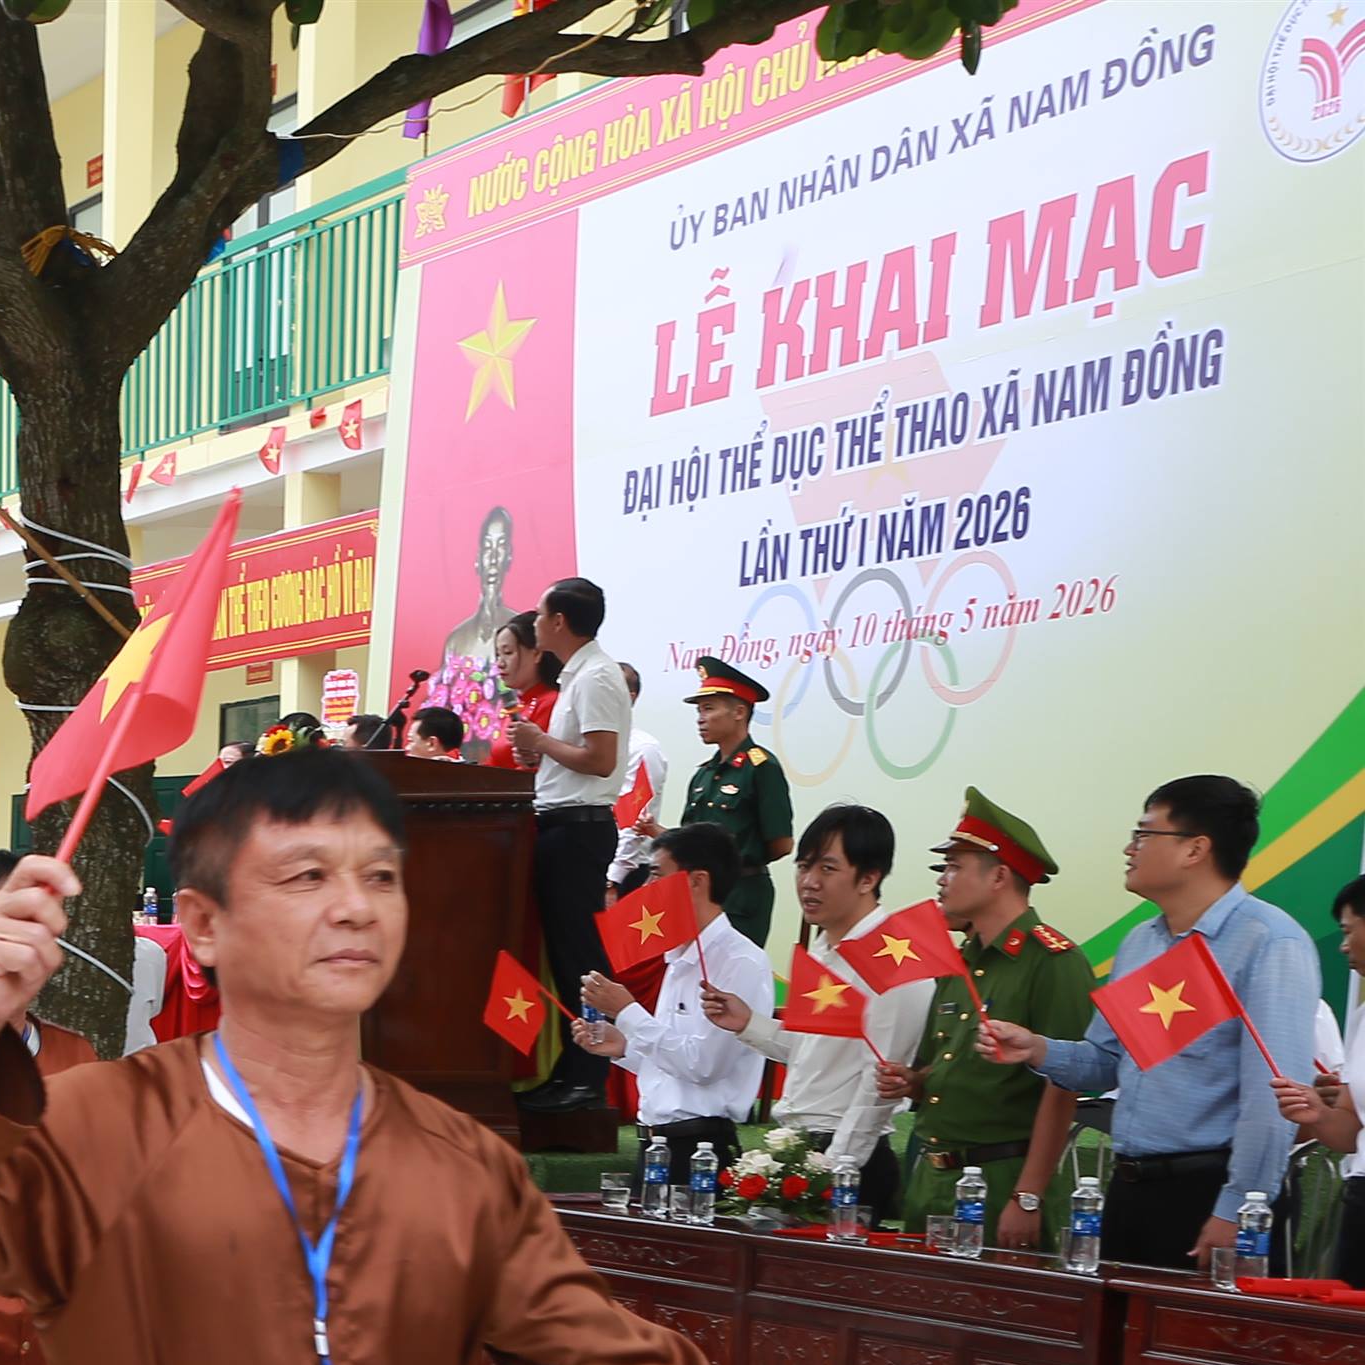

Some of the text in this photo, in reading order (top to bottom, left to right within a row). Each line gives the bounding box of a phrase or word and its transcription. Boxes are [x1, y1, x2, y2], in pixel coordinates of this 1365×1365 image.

[467, 150, 529, 219] NƯỚC
[532, 129, 598, 197] CỘNG
[601, 103, 651, 168] HÒA
[656, 79, 694, 146] XÃ
[698, 62, 746, 132] HỘI
[751, 20, 811, 107] CHỦ
[670, 23, 1216, 251] ỦY BAN NHÂN DÂN XÃ NAM ĐỒNG
[649, 149, 1211, 417] LỄ KHAI MẠC
[623, 320, 1225, 522] ĐẠI HỘI THỂ DỤC THỂ THAO XÃ NAM ĐỒNG
[720, 622, 780, 670] Đồng,
[788, 619, 843, 664] ngày
[848, 612, 878, 649] 10
[882, 604, 954, 647] tháng
[959, 596, 978, 633] 5
[981, 590, 1042, 631] năm
[1047, 573, 1121, 621] 2026
[738, 485, 1032, 588] LẦN THỨ I NĂM 2026
